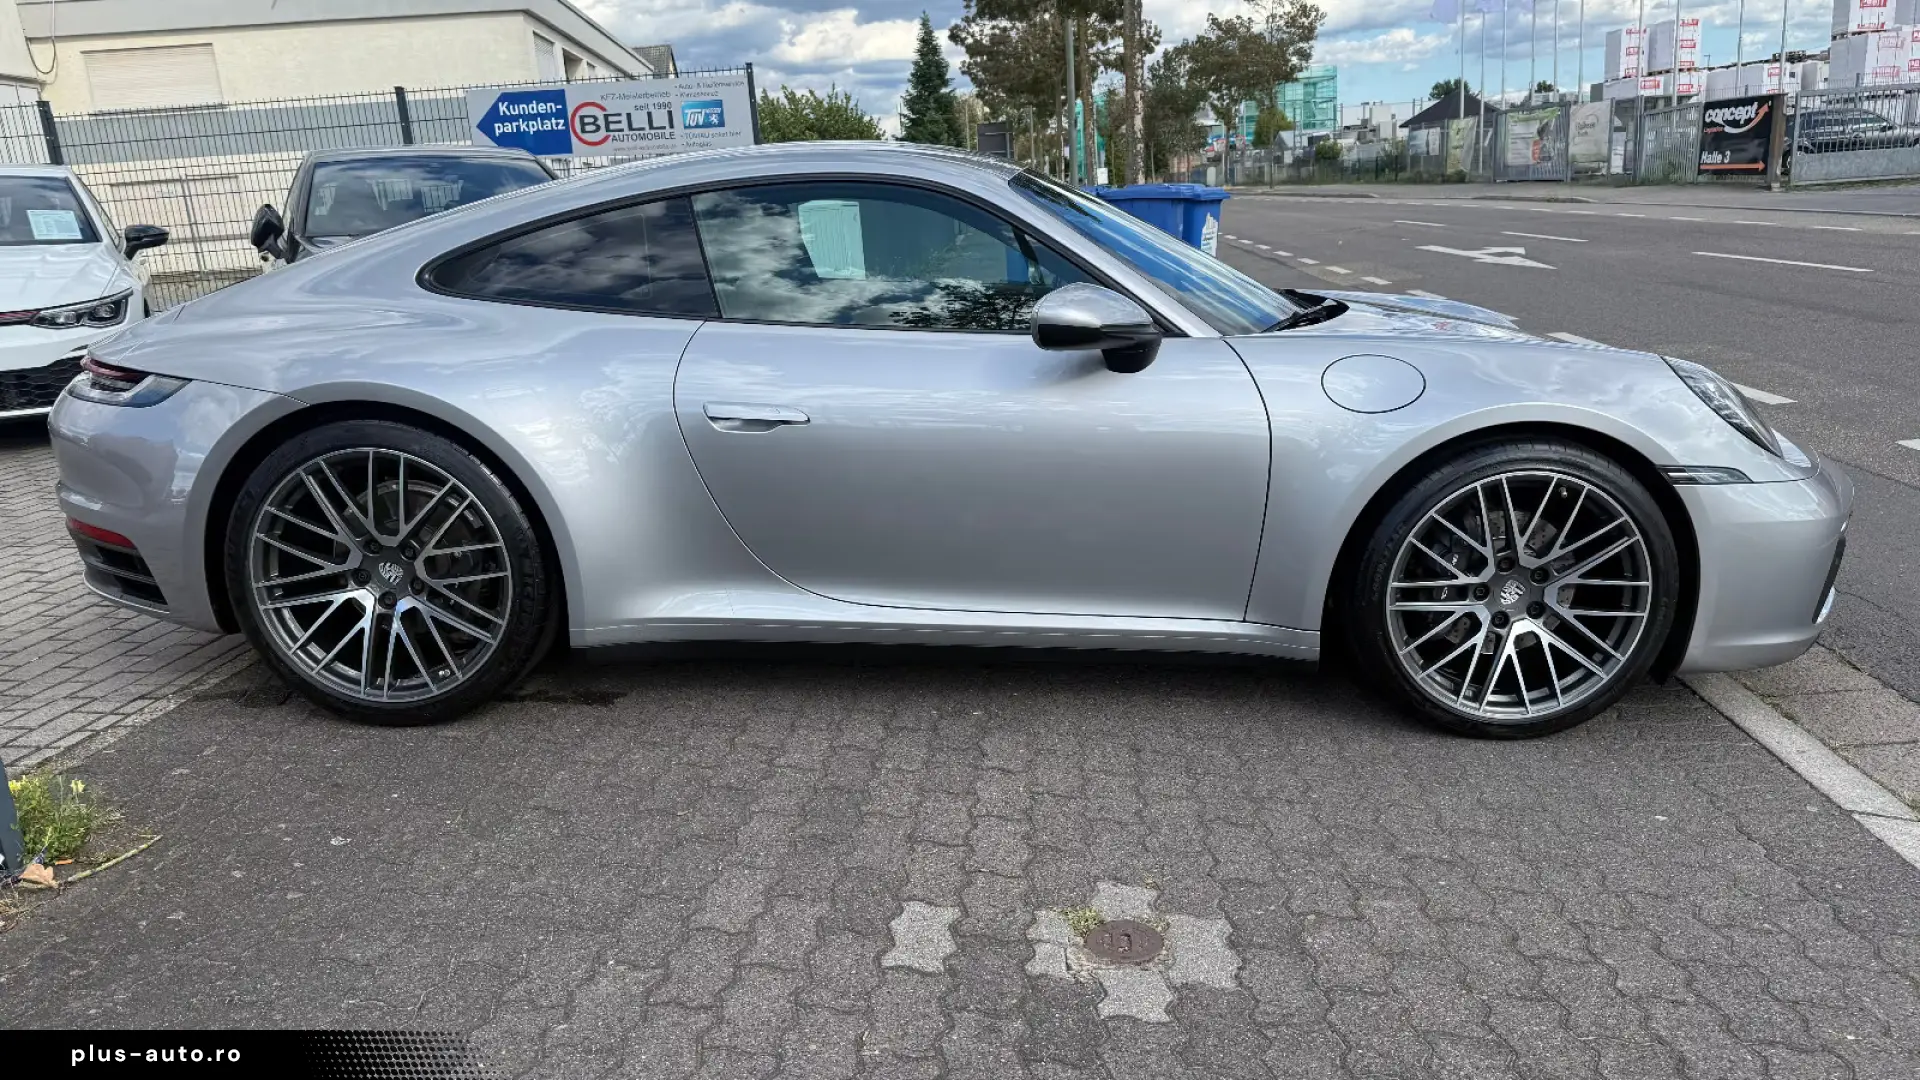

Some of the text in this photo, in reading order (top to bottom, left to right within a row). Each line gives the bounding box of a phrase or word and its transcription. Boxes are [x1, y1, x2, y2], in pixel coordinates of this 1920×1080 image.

[498, 100, 563, 116] Kunden-
[634, 101, 673, 111] seit 1990
[1705, 101, 1758, 125] concept
[494, 117, 566, 137] parkplatz
[611, 131, 676, 143] AUTOMOBILE
[1700, 149, 1731, 164] Halle 3
